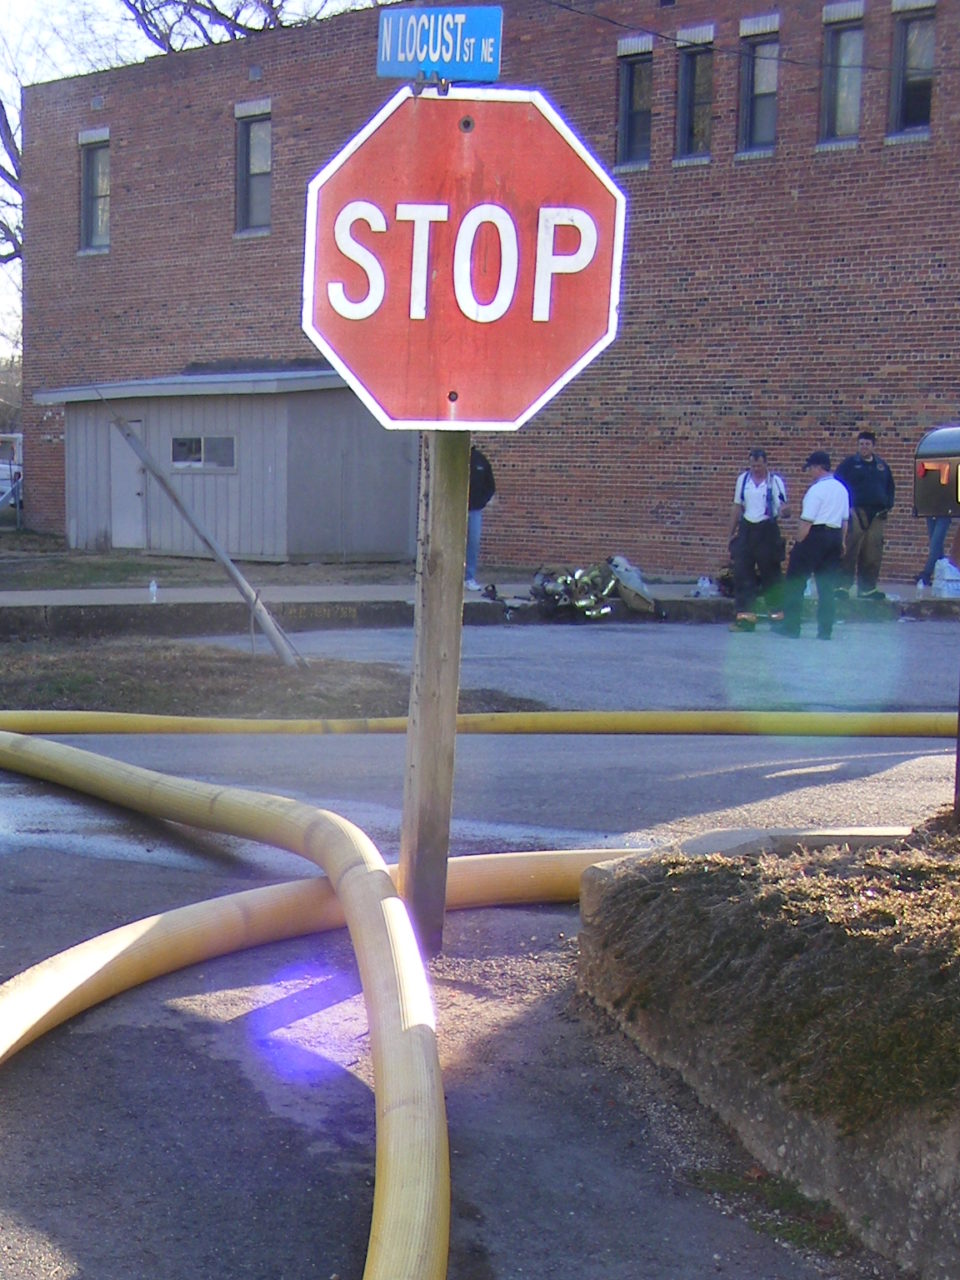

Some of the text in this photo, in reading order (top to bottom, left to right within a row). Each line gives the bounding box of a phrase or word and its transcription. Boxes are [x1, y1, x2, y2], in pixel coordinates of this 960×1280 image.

[381, 13, 495, 63] N LOCUST ST NE
[327, 200, 598, 324] STOP
